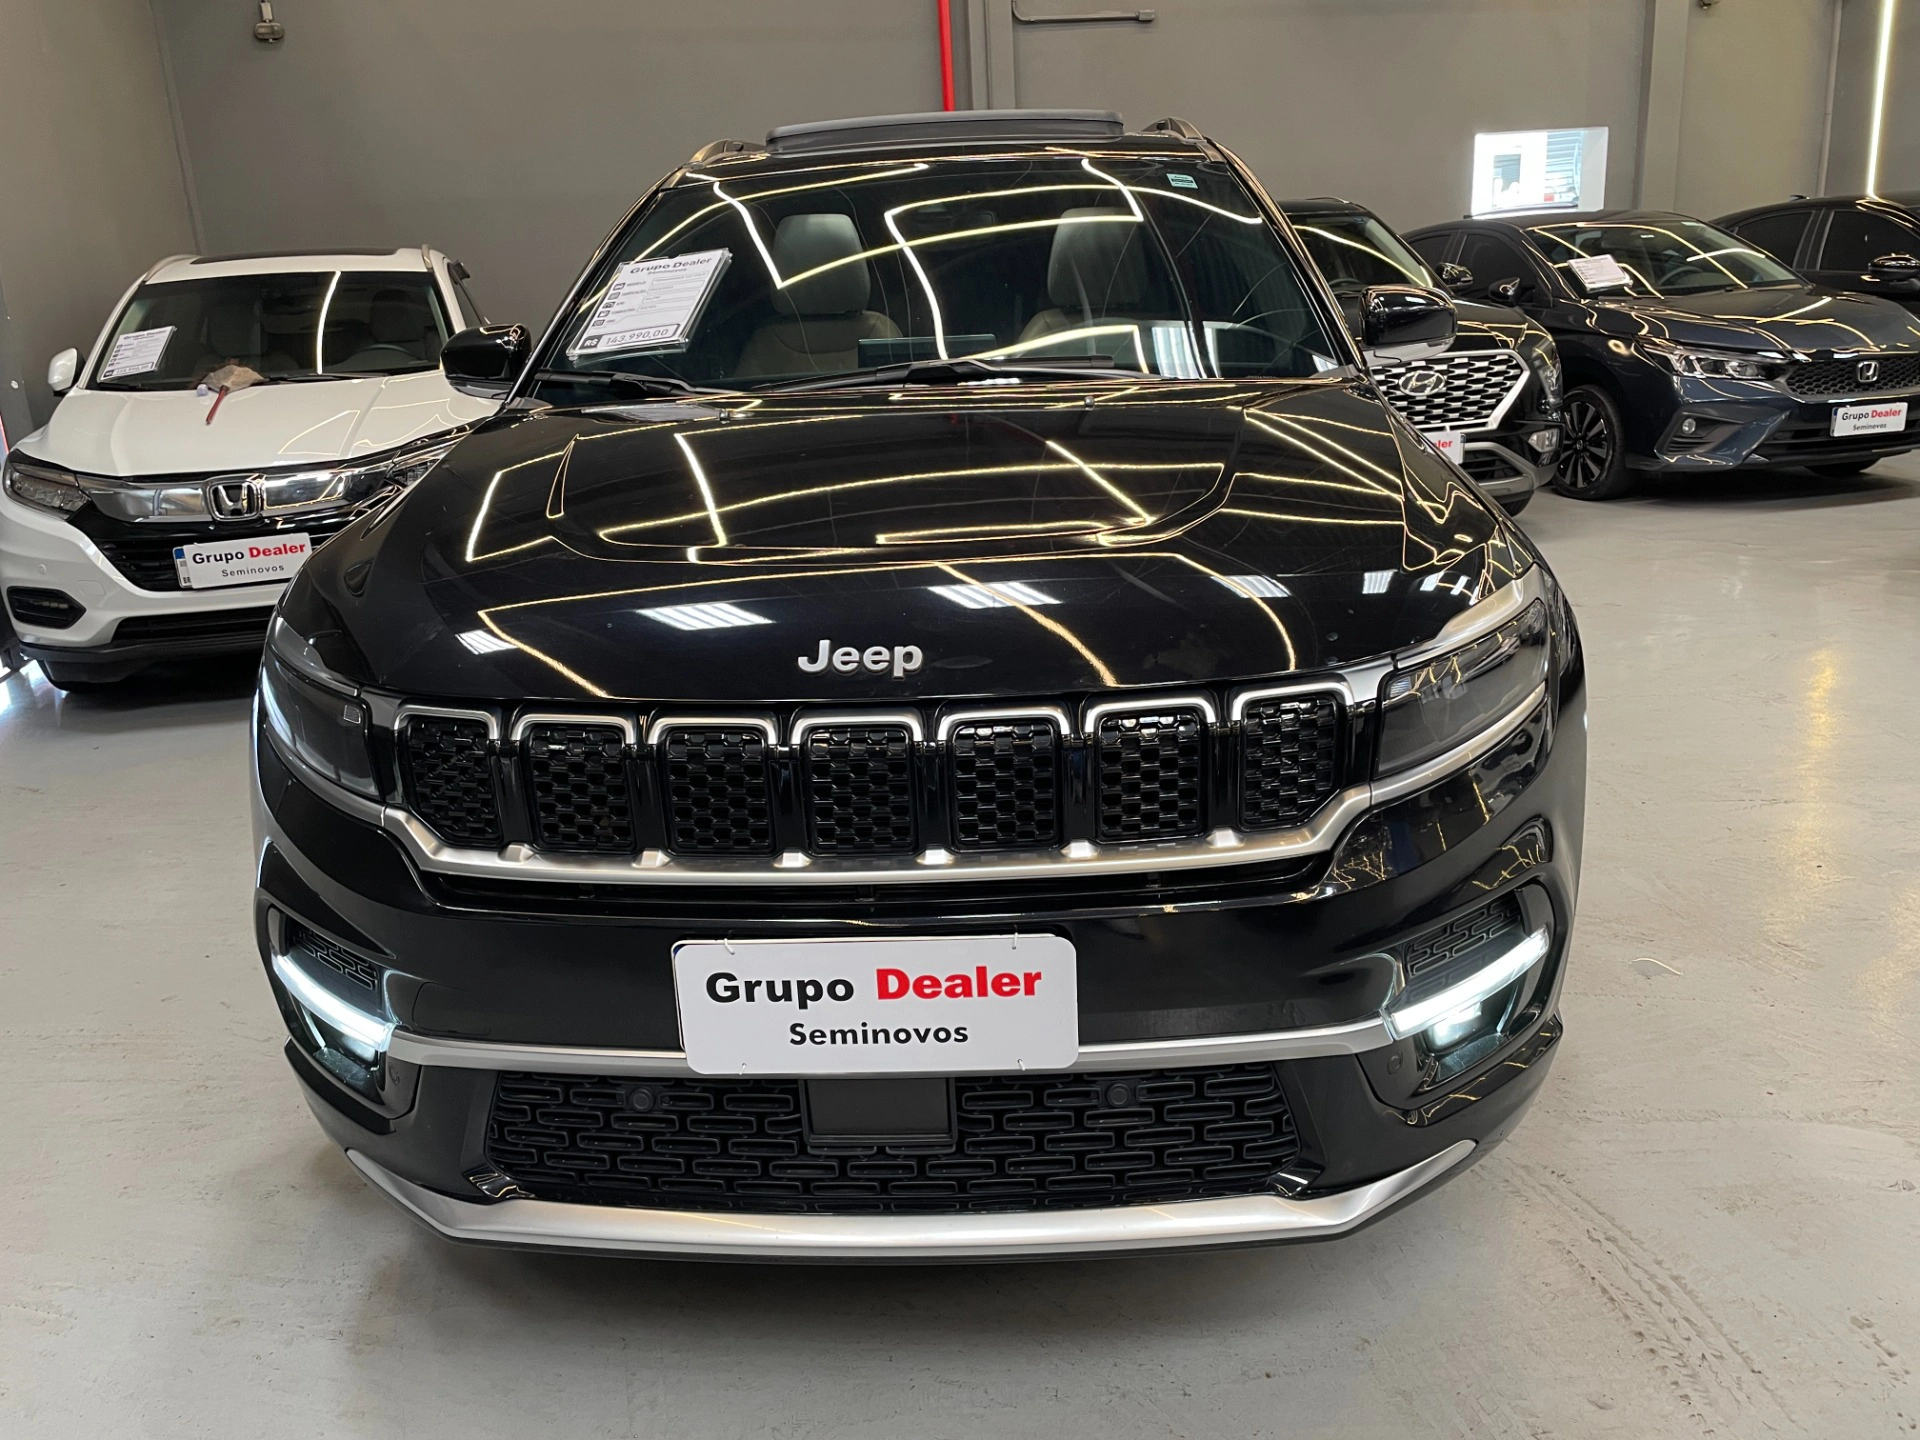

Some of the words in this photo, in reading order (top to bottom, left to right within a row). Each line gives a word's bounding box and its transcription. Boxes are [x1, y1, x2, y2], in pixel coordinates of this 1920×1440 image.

[630, 264, 670, 274] Grupo
[672, 258, 713, 268] Dealer
[1841, 412, 1870, 421] Grupo
[1871, 408, 1902, 418] Dealer
[1852, 423, 1887, 431] Seminovos
[192, 550, 245, 564] Grupo
[248, 543, 306, 558] Dealer
[221, 564, 285, 577] Seminovos
[797, 639, 923, 679] Jeep
[705, 972, 855, 1010] Grupo
[876, 965, 1043, 1000] Dealer
[789, 1021, 969, 1046] Seminovos
